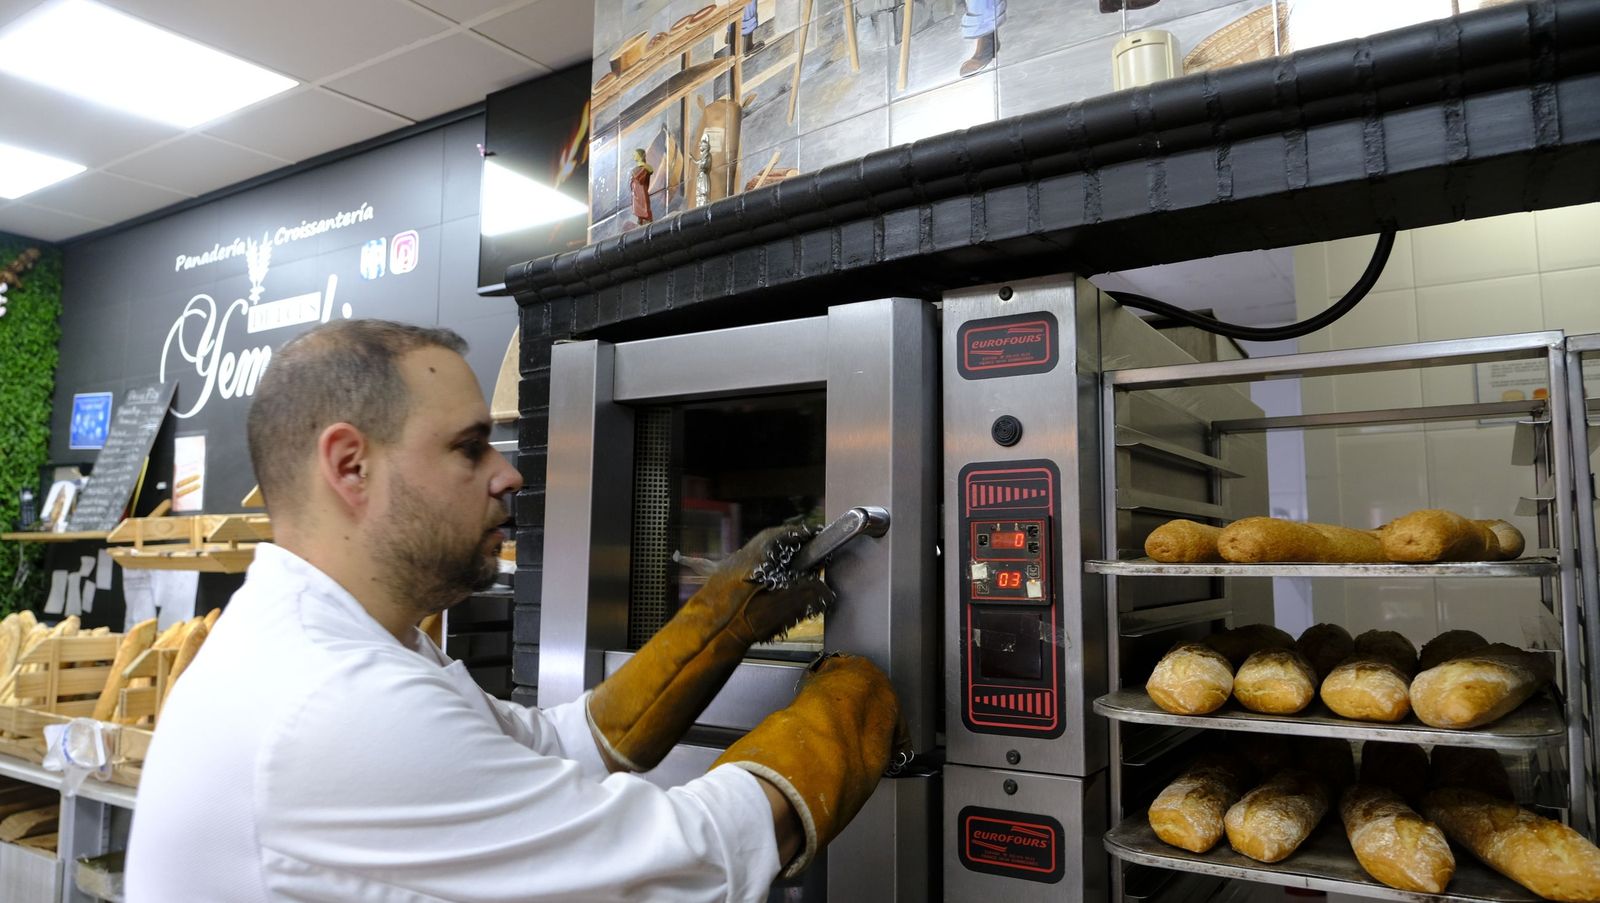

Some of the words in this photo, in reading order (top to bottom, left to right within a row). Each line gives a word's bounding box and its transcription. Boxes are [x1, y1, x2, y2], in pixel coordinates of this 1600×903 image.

[175, 237, 246, 272] Panadería
[274, 202, 374, 246] Croissantería
[999, 572, 1021, 587] 03
